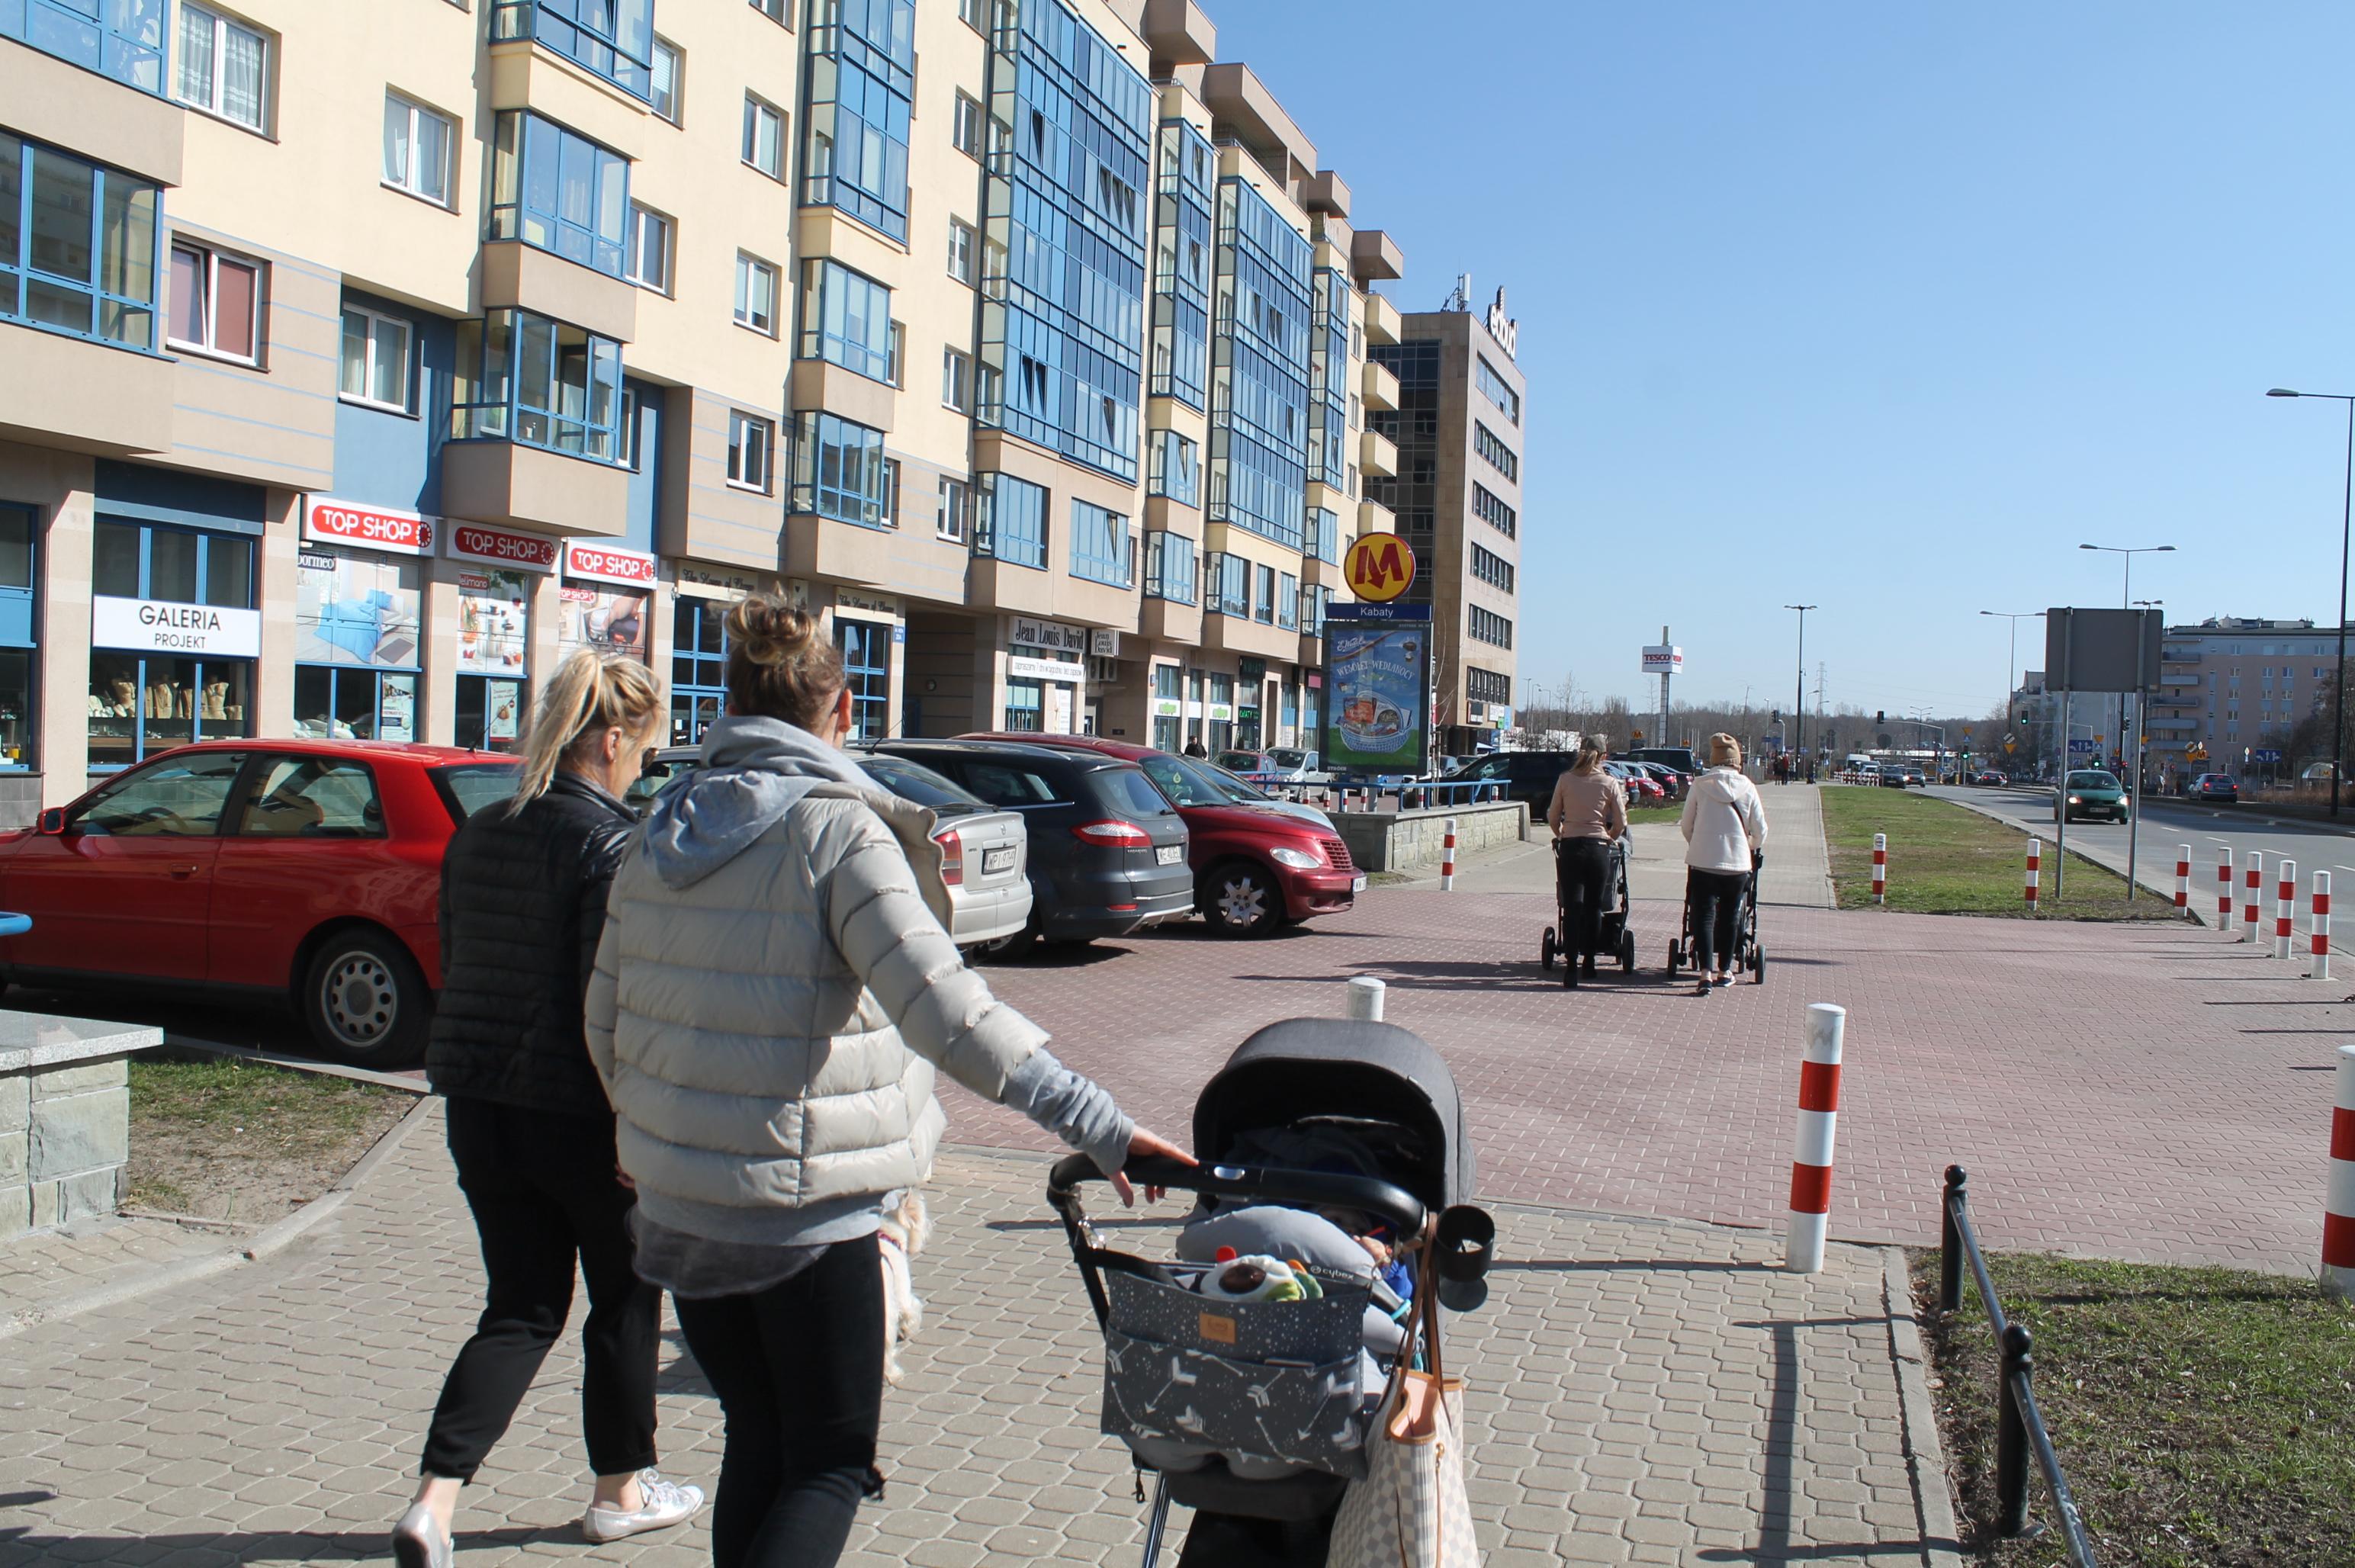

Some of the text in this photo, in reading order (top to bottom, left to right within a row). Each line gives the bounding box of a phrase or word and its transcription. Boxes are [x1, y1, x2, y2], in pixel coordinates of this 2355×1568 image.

[322, 509, 412, 540] TOP SHOP
[463, 532, 537, 558] TOP SHOP
[577, 551, 639, 576] TOP SHOP
[571, 590, 588, 600] SHOP
[140, 606, 221, 631] GALERIA
[1361, 607, 1393, 618] Kabaty
[155, 633, 206, 648] PROJEKT
[1016, 620, 1084, 649] Jean Louis David
[1095, 631, 1109, 640] Jean
[1095, 638, 1112, 646] Louis
[1095, 645, 1112, 654] David
[1322, 1269, 1354, 1280] cybex
